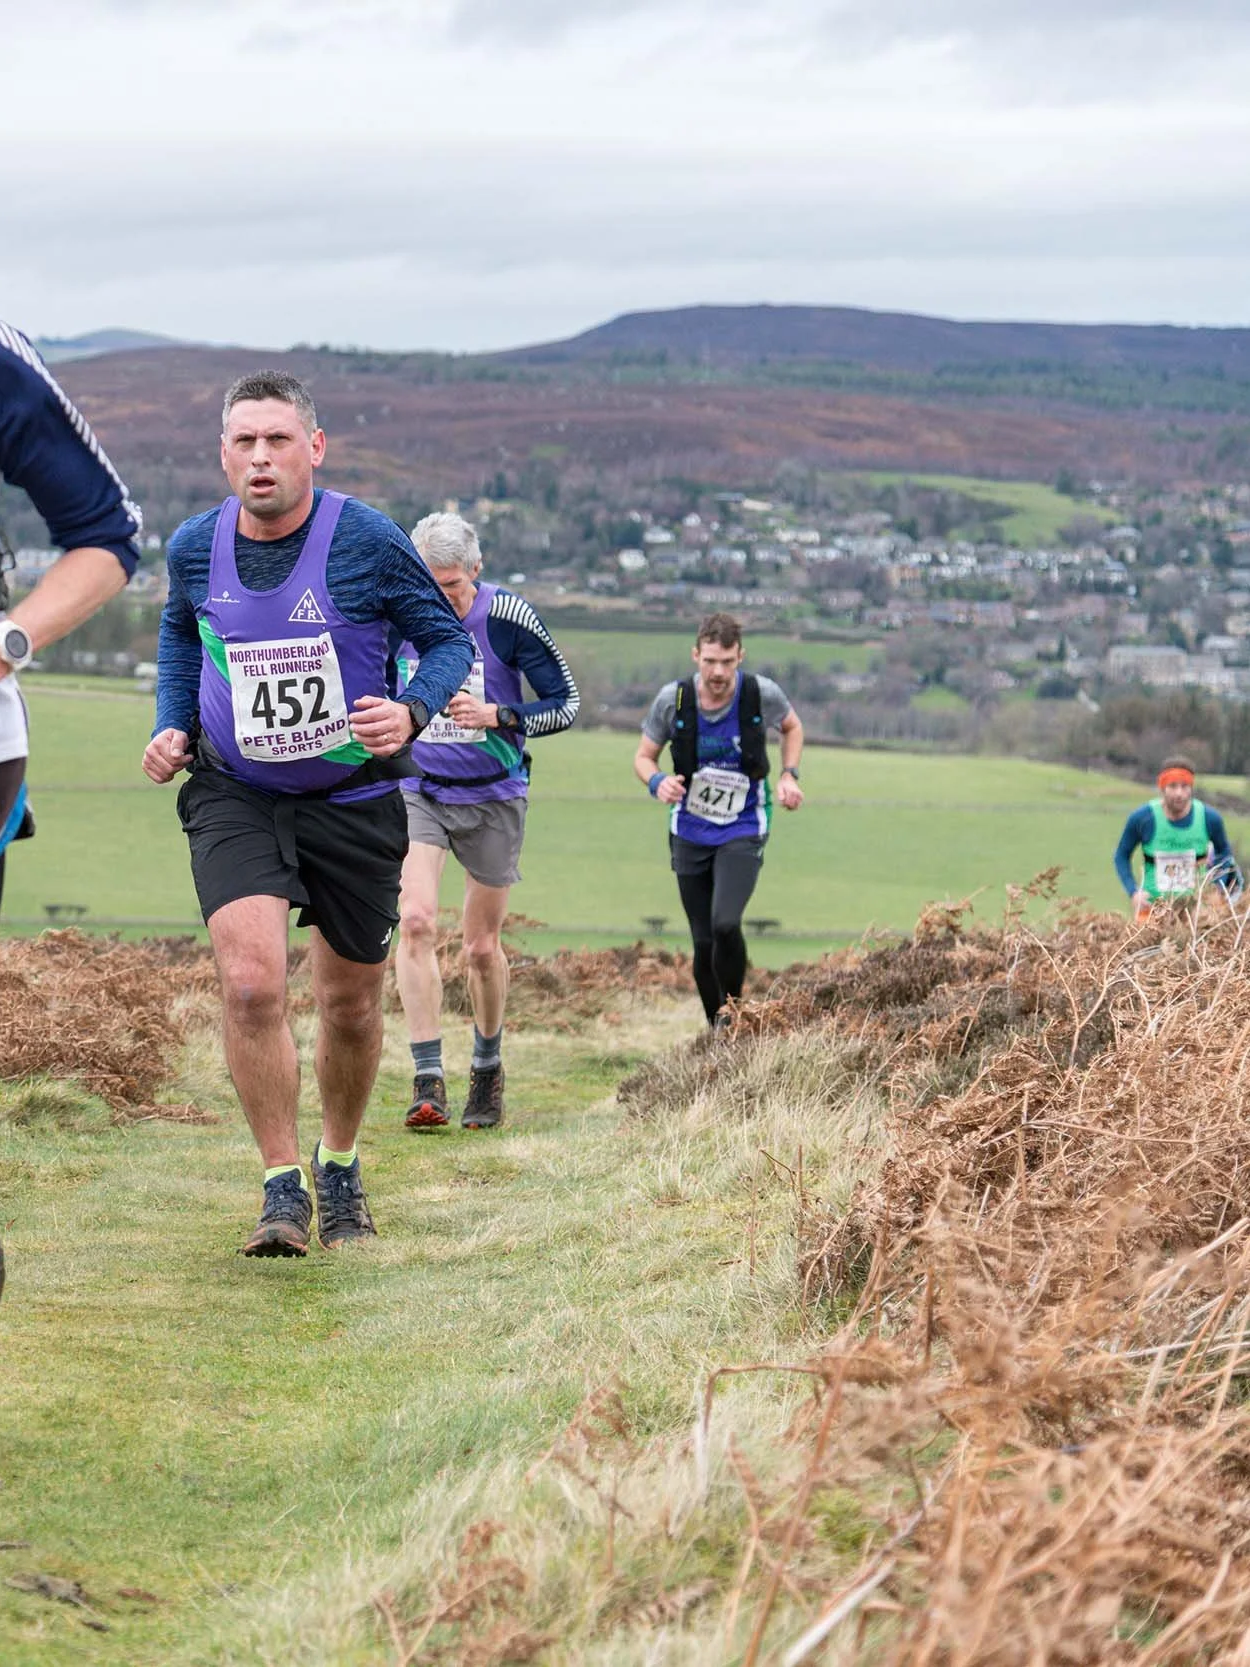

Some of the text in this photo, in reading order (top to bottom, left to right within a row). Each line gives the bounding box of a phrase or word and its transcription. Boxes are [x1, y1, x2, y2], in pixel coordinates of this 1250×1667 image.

[229, 641, 330, 664] NORTHUMBERLAND
[243, 659, 323, 677] FELL RUNNERS
[251, 676, 330, 729] 452
[243, 718, 346, 747] PETE BLAND
[271, 740, 323, 755] SPORTS
[699, 785, 735, 811] 471
